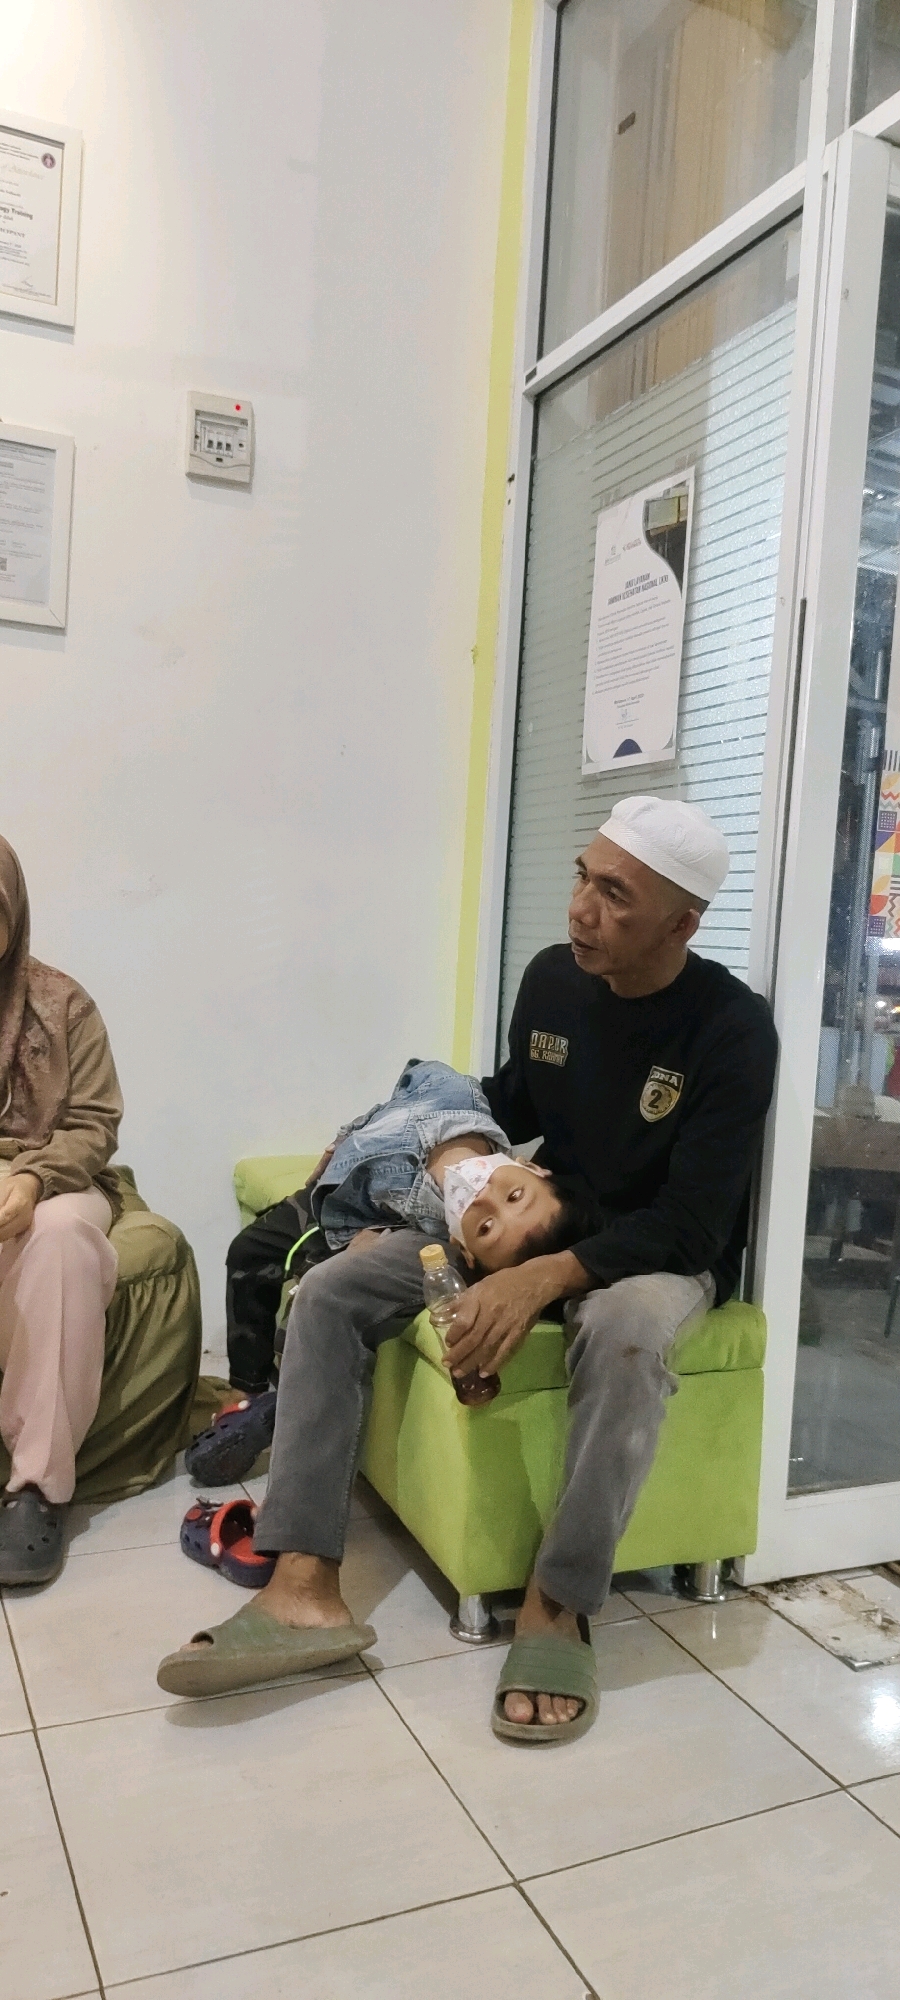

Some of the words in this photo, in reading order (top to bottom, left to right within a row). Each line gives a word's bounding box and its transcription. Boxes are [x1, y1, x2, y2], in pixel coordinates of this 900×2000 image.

[11, 208, 33, 221] Training
[531, 1032, 566, 1053] DAPUR
[650, 1071, 678, 1087] DNA
[648, 1089, 663, 1109] 2
